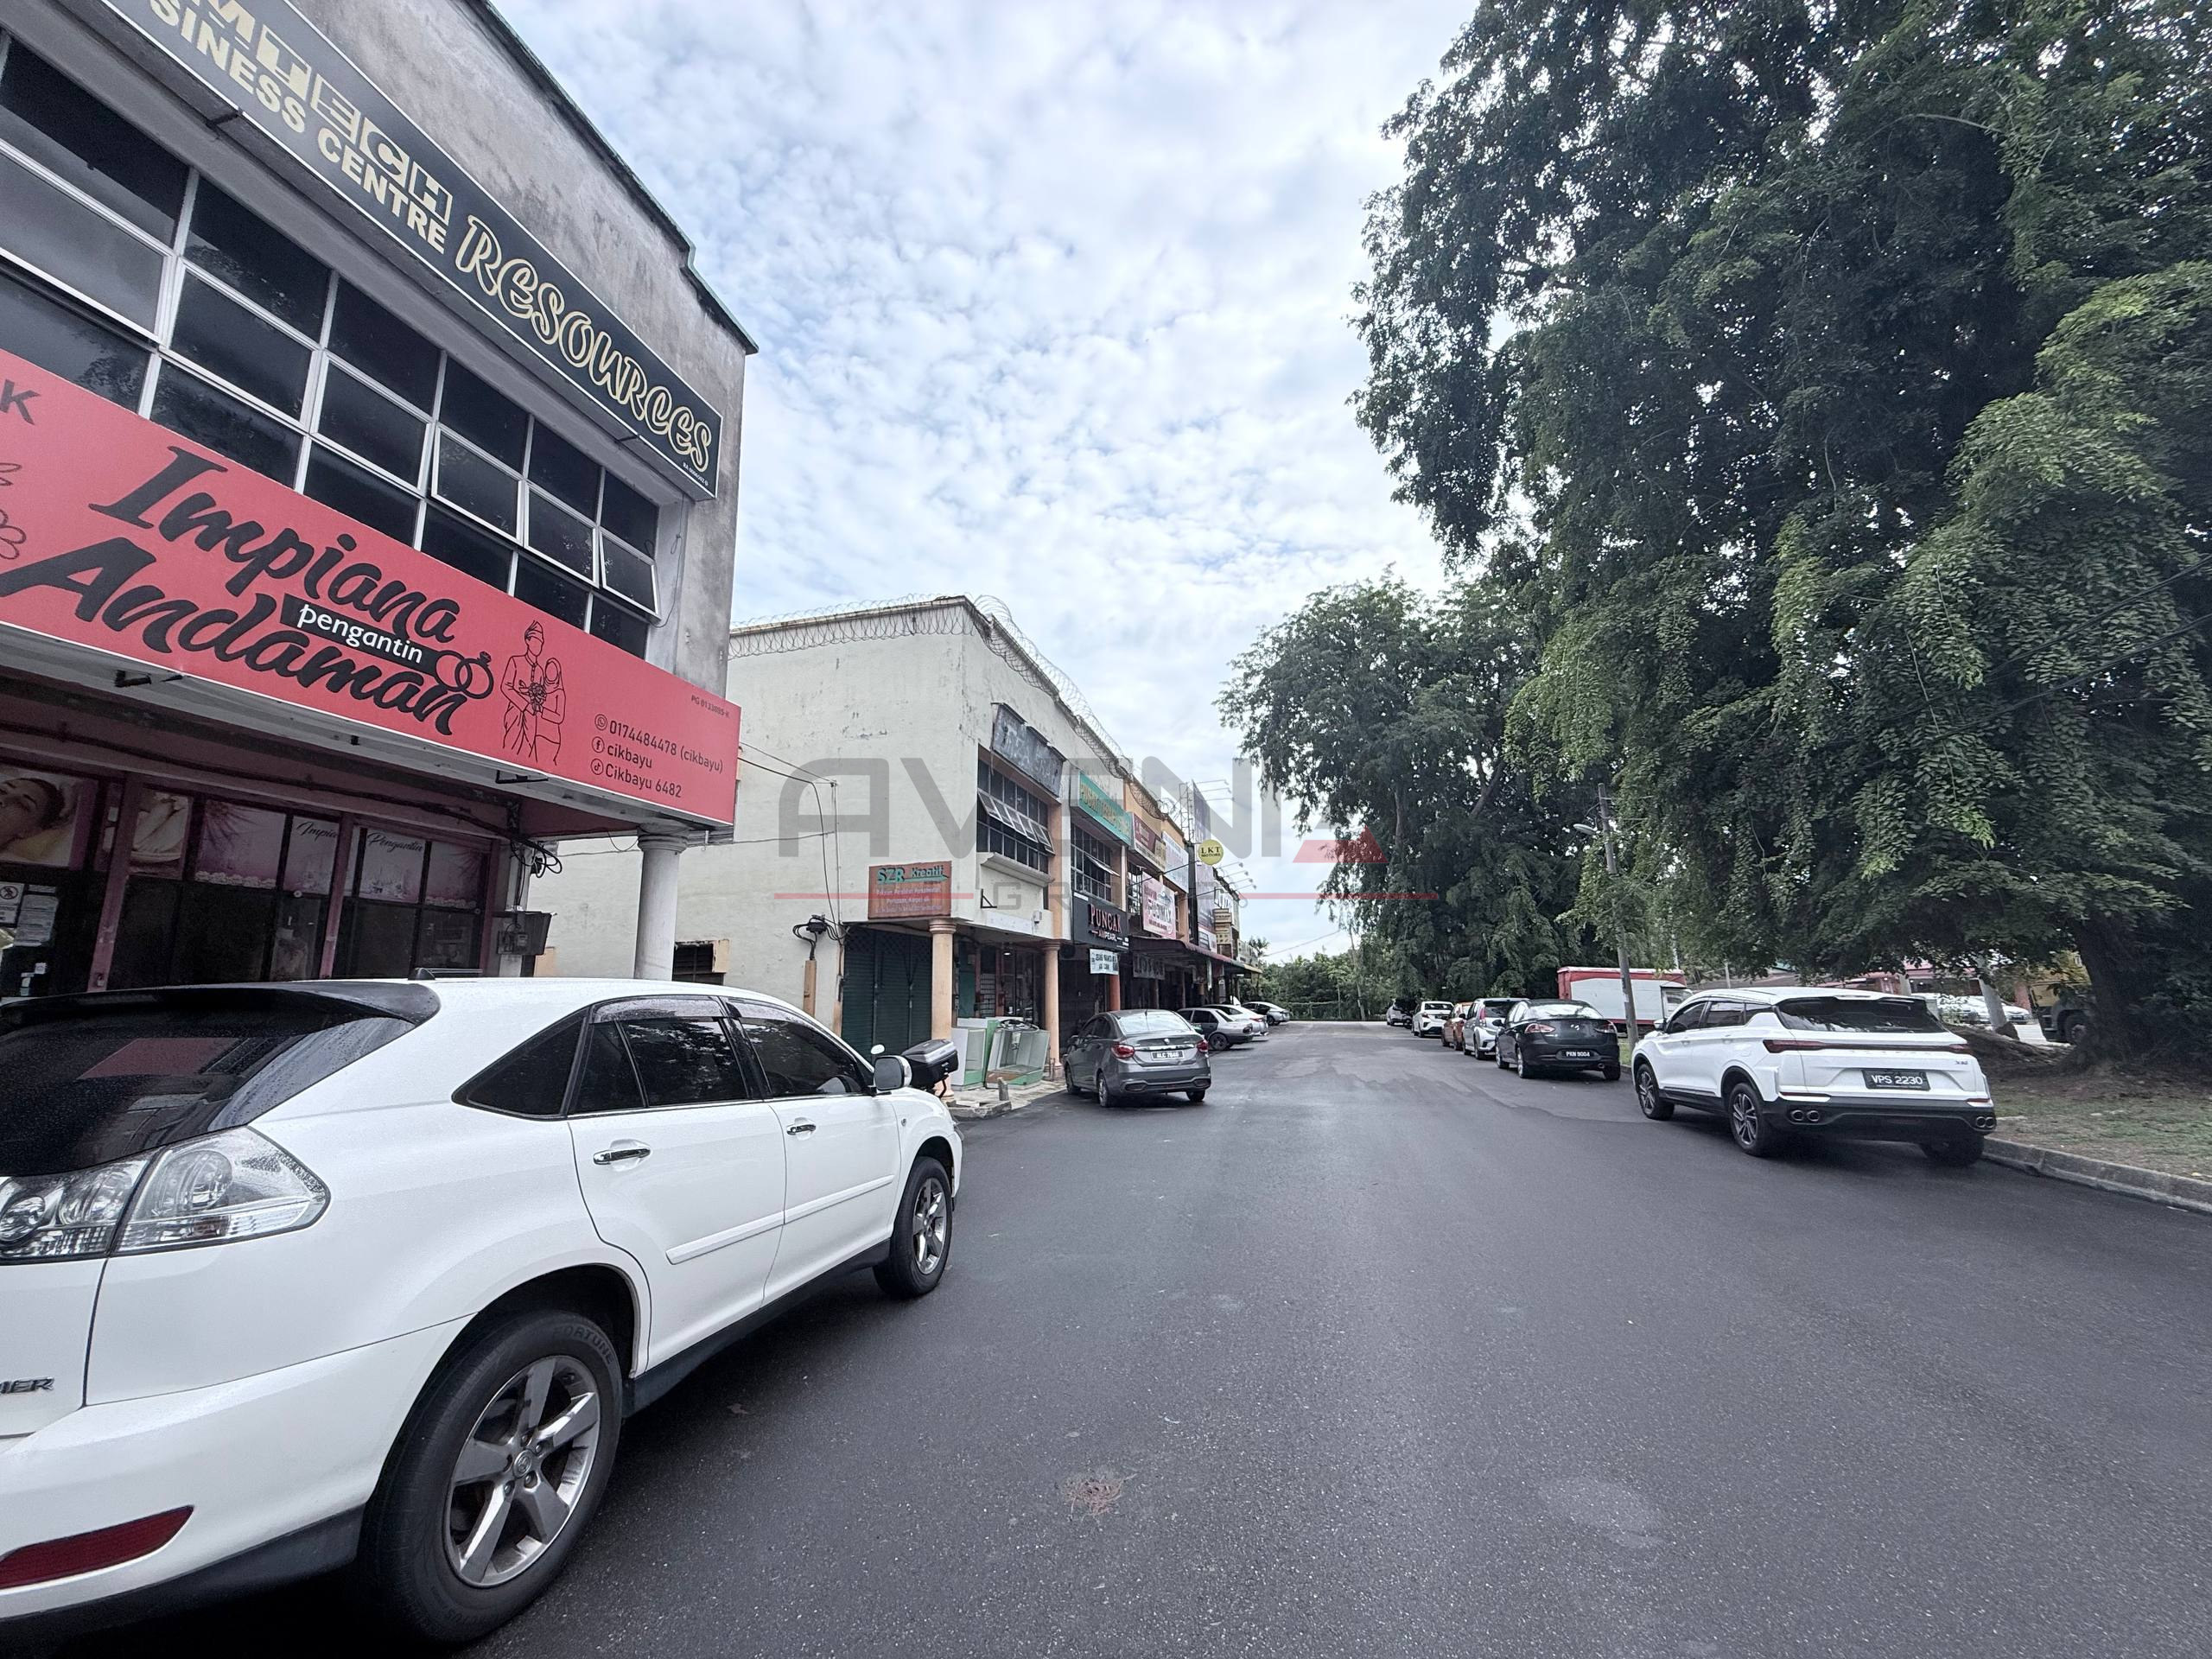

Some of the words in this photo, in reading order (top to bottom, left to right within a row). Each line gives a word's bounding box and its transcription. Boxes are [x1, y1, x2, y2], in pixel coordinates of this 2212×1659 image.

[317, 127, 448, 255] CENTRE
[88, 445, 461, 644] Impiana
[0, 537, 467, 735] Andaman
[296, 603, 424, 665] pengantin
[607, 742, 653, 770] cikbayu
[609, 720, 677, 756] 0174484478
[680, 745, 723, 774] (cikbayu)
[605, 763, 652, 791] Cikbayu
[655, 780, 683, 798] 6482
[877, 866, 906, 885] SZR
[1090, 903, 1122, 934] PUNCAK
[1871, 1074, 1892, 1084] VPS
[1895, 1075, 1923, 1085] 2230
